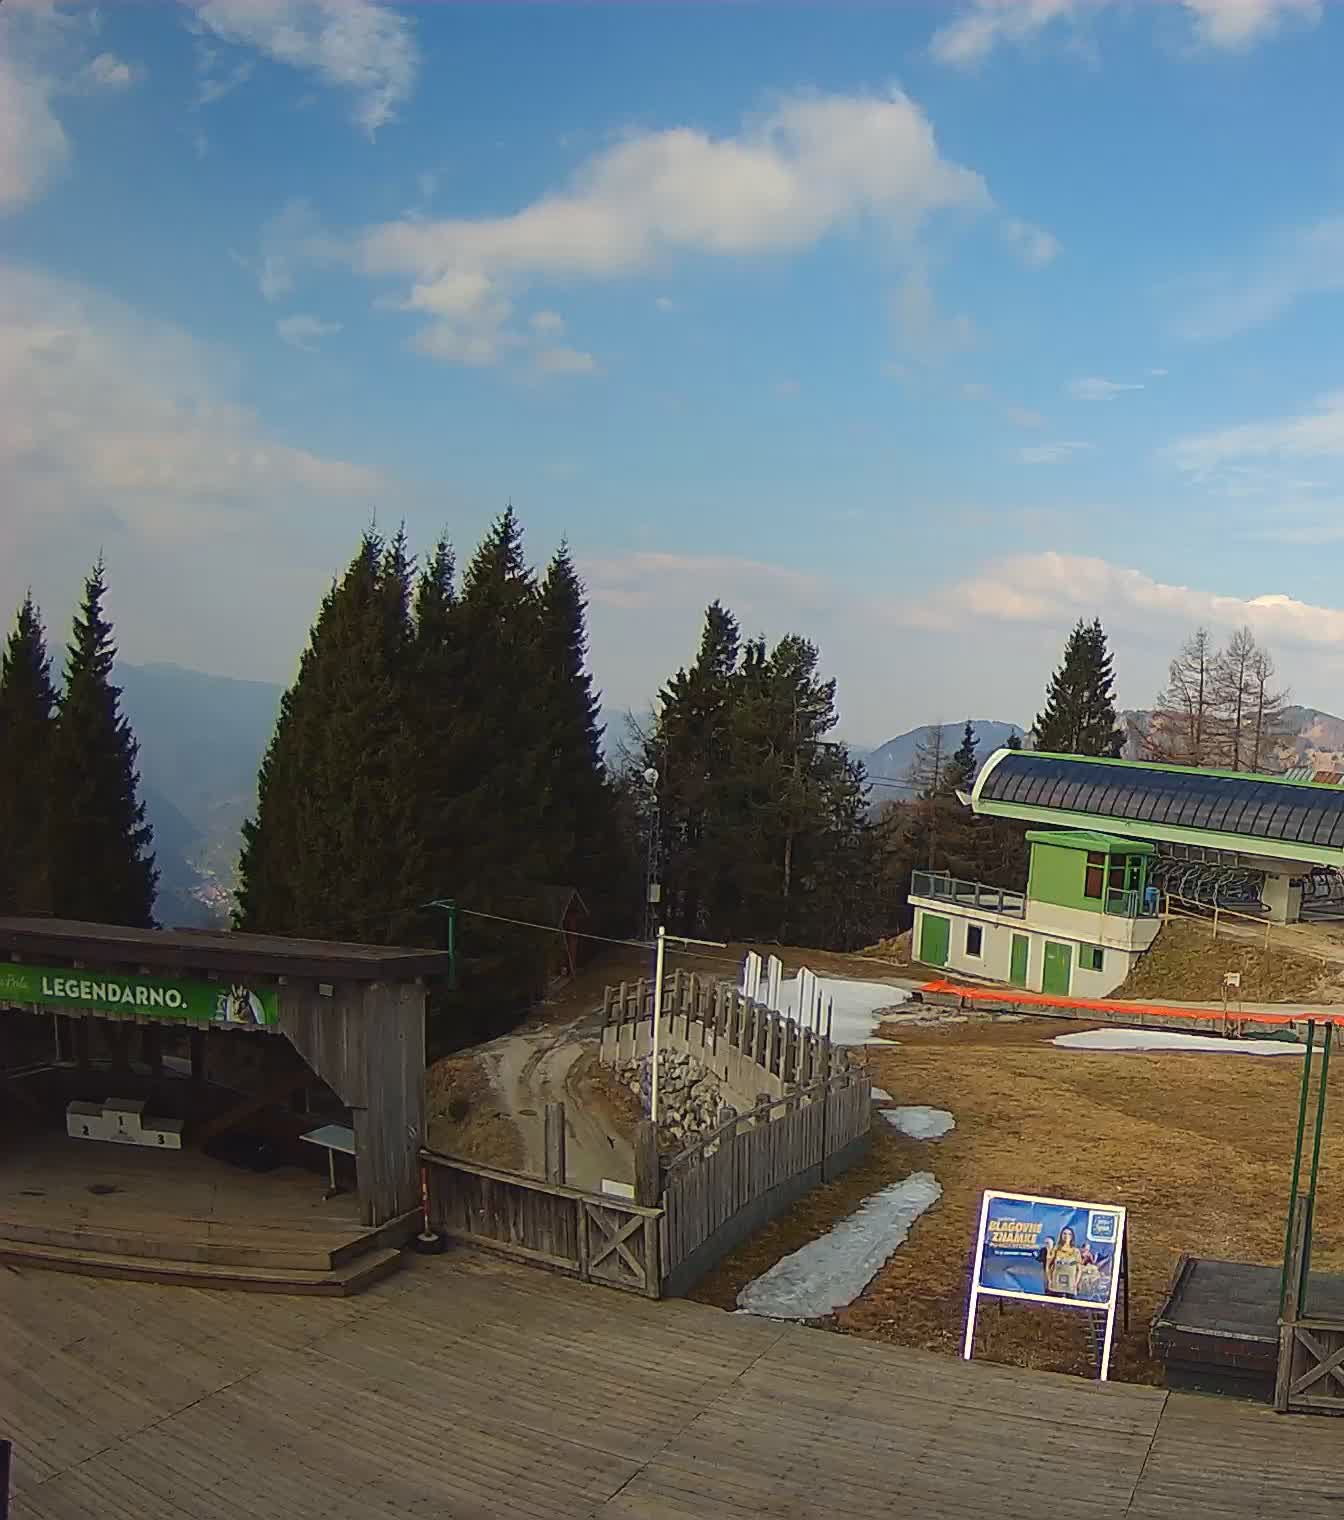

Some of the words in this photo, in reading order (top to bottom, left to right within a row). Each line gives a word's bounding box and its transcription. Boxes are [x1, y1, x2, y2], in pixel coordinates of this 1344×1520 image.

[41, 976, 188, 1009] LEGENDARNO.
[81, 1125, 90, 1136] 2
[156, 1134, 165, 1145] 3
[991, 1231, 1038, 1244] ZNAMKE
